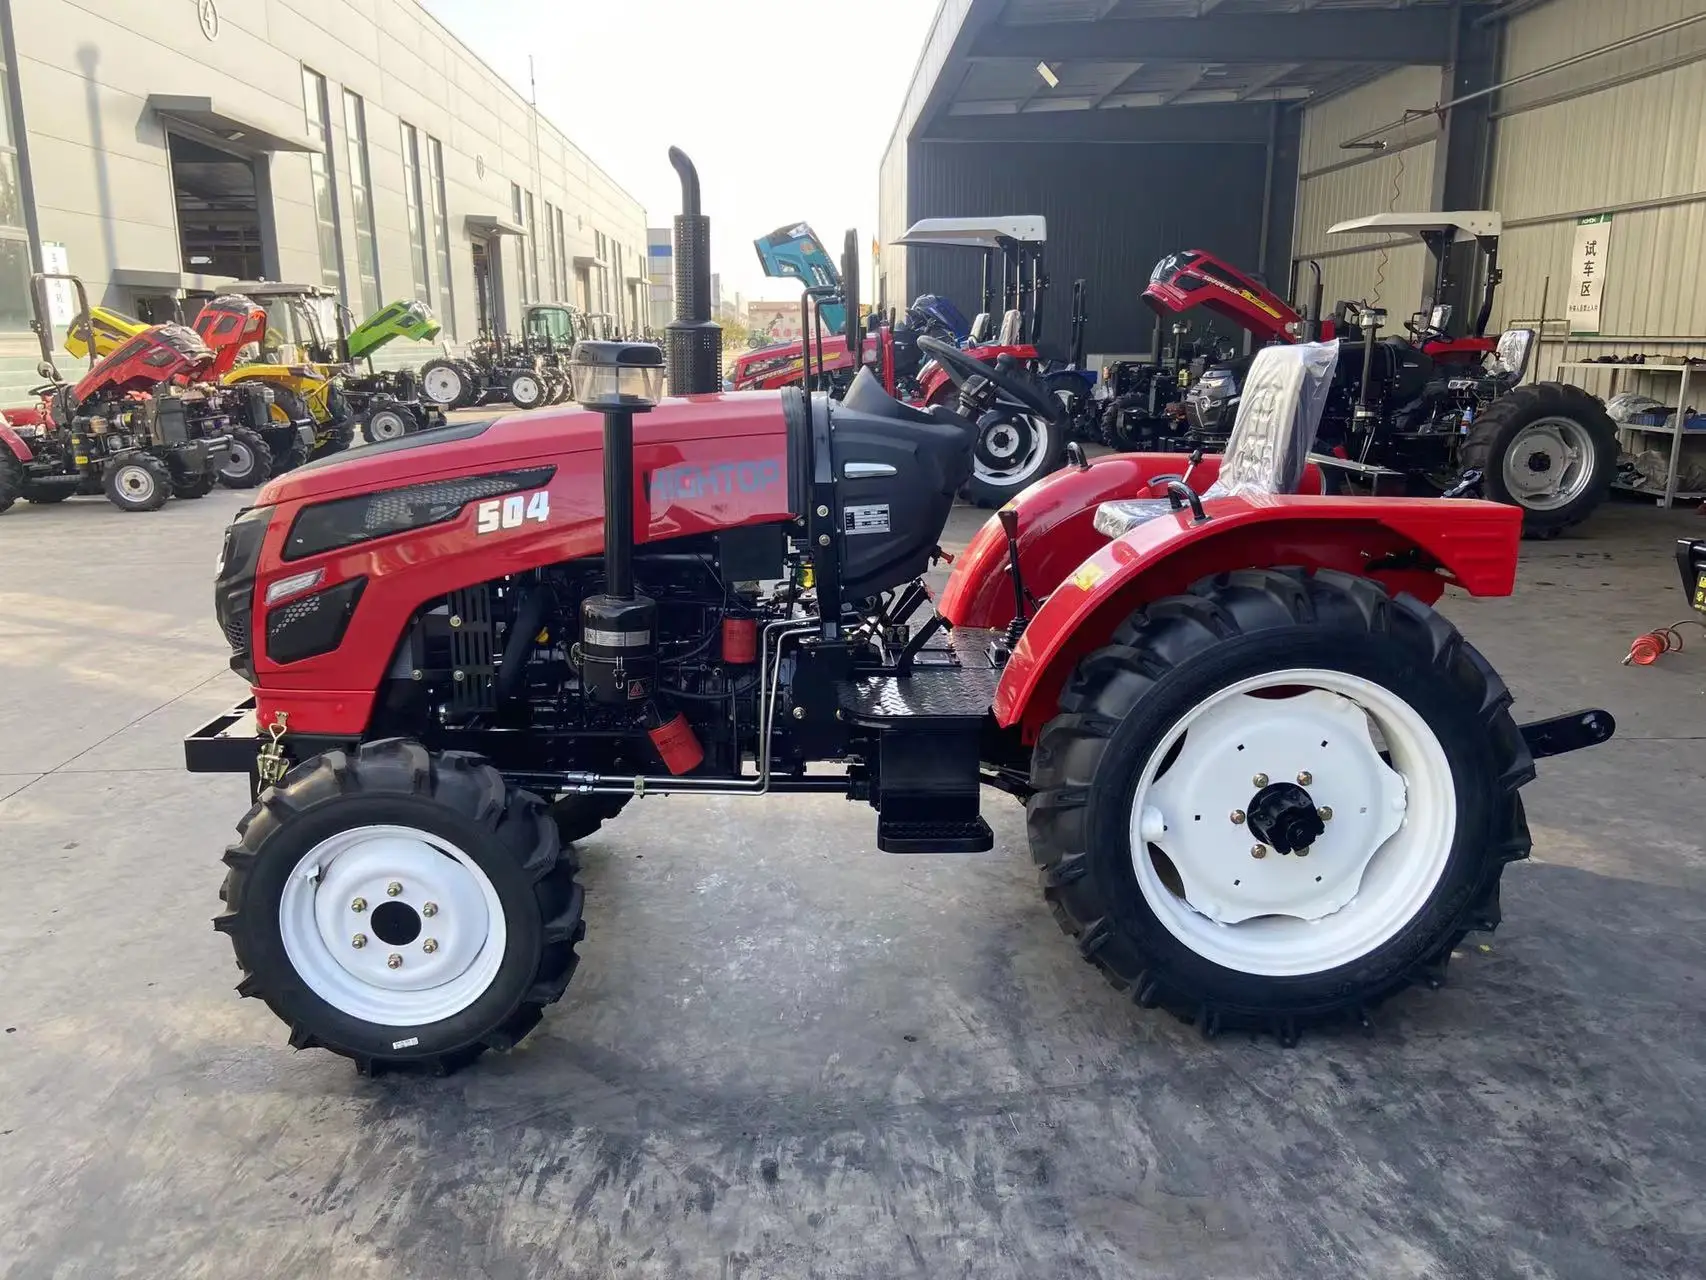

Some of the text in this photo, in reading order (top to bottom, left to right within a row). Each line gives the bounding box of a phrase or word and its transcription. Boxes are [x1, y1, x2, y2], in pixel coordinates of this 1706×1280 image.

[1580, 240, 1597, 296] 试车区
[644, 459, 779, 501] HIGHTOP
[478, 491, 550, 533] 504
